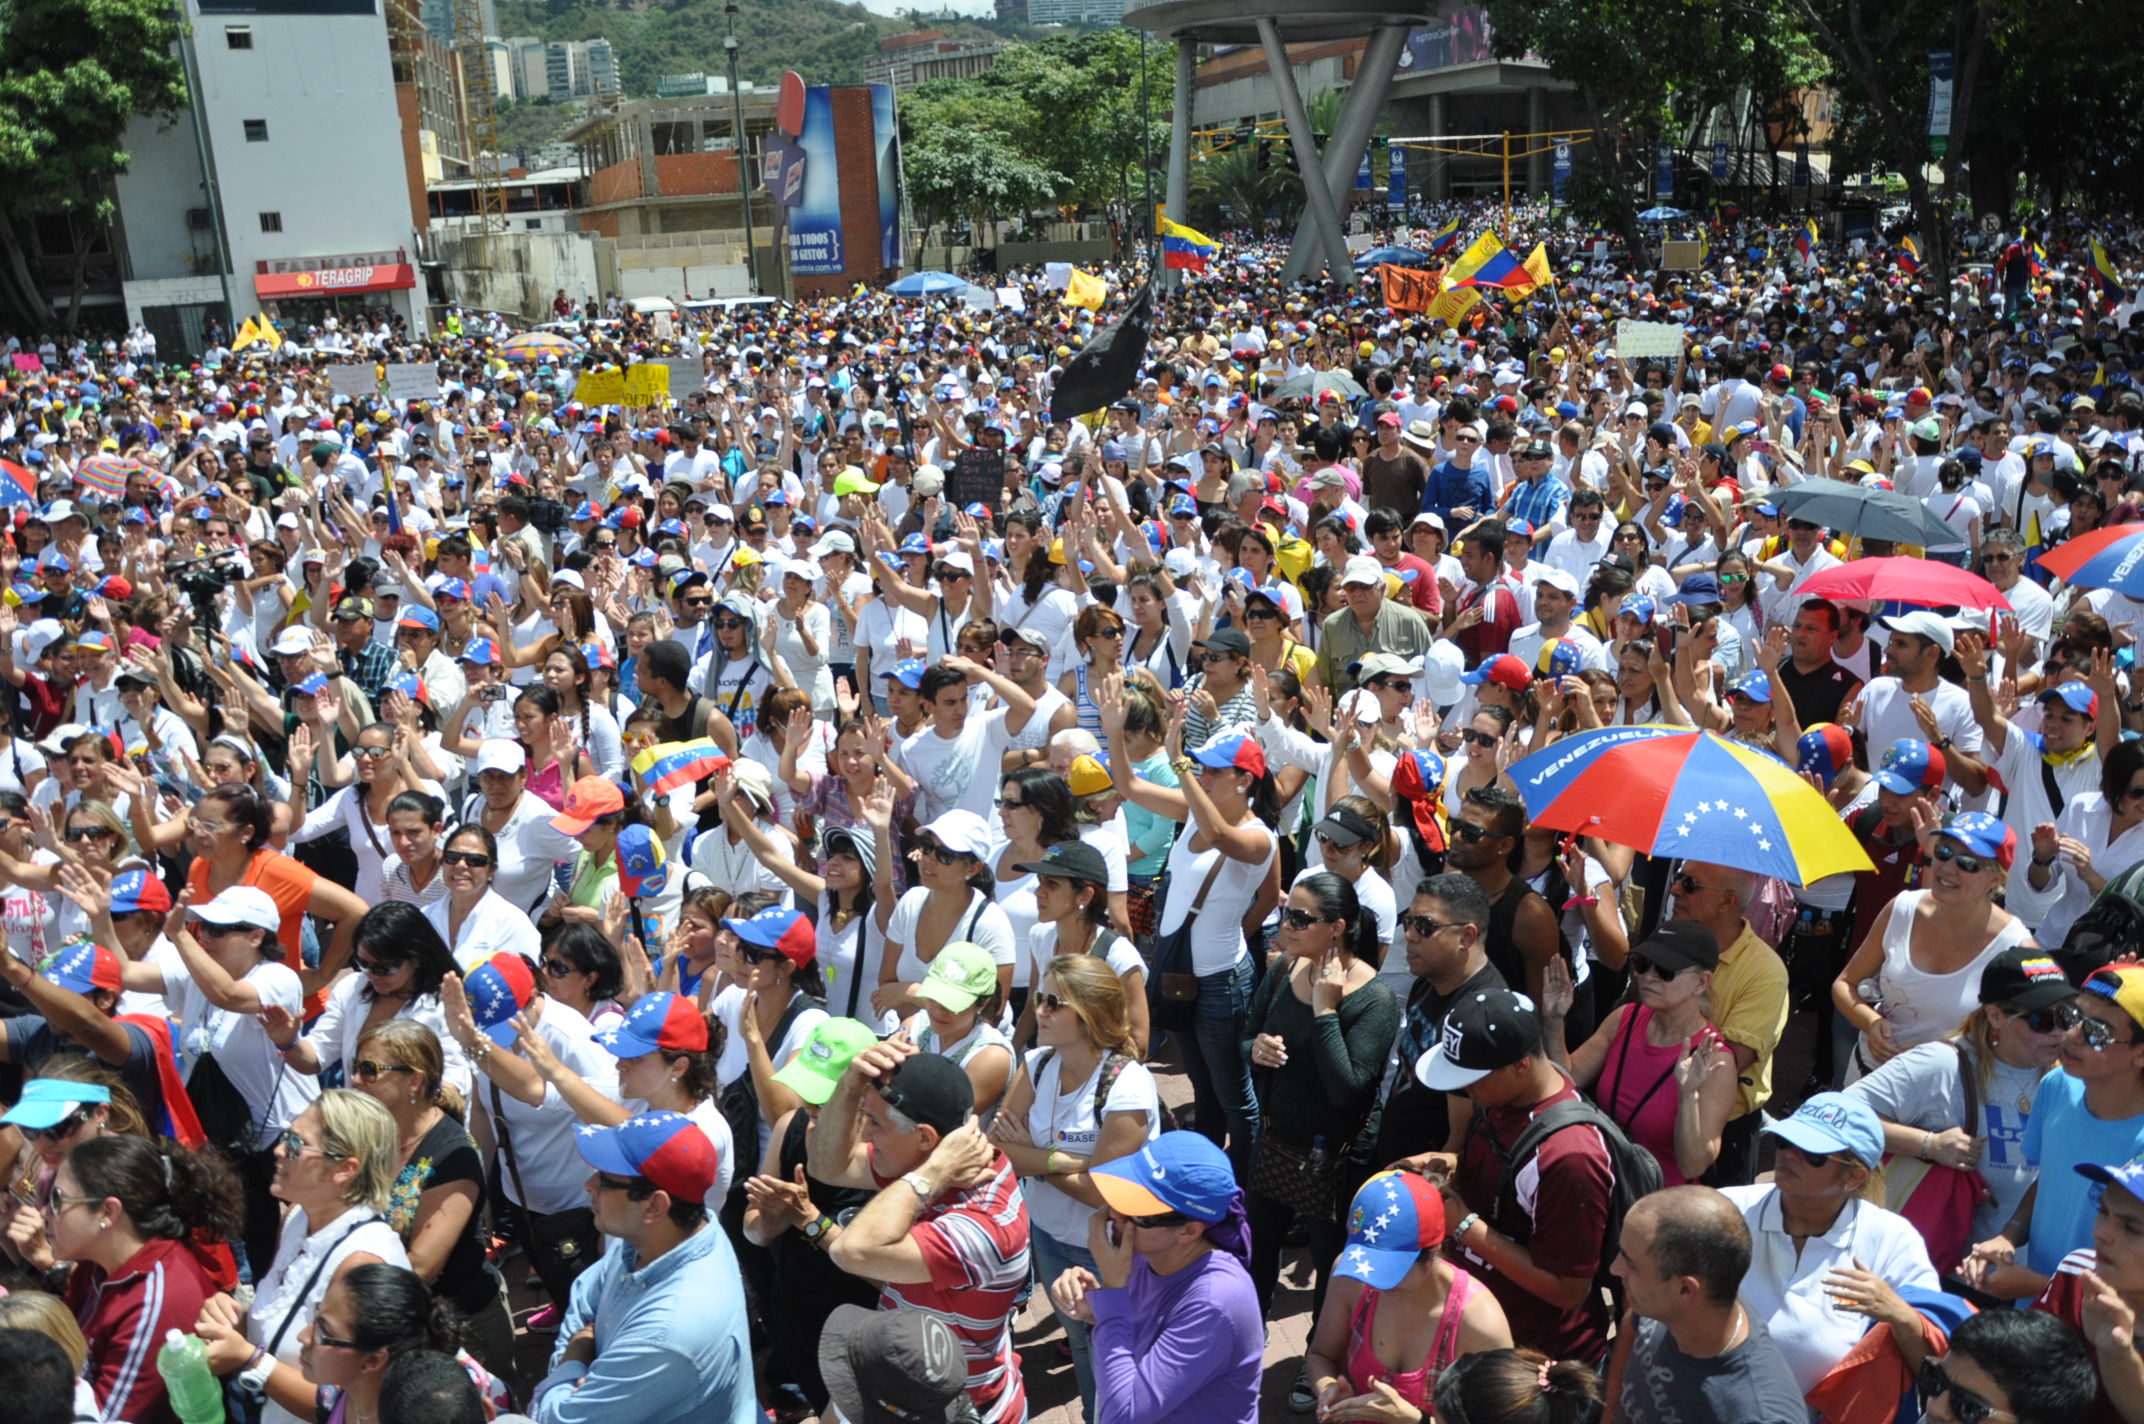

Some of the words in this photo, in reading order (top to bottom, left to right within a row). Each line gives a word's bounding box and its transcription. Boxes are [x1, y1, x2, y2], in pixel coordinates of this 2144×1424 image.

[801, 231, 829, 246] TODOS
[314, 267, 375, 286] TERAGRIP
[962, 452, 996, 463] BASTA
[1529, 729, 1670, 786] VENEZUELA
[1067, 1134, 1097, 1143] BASE
